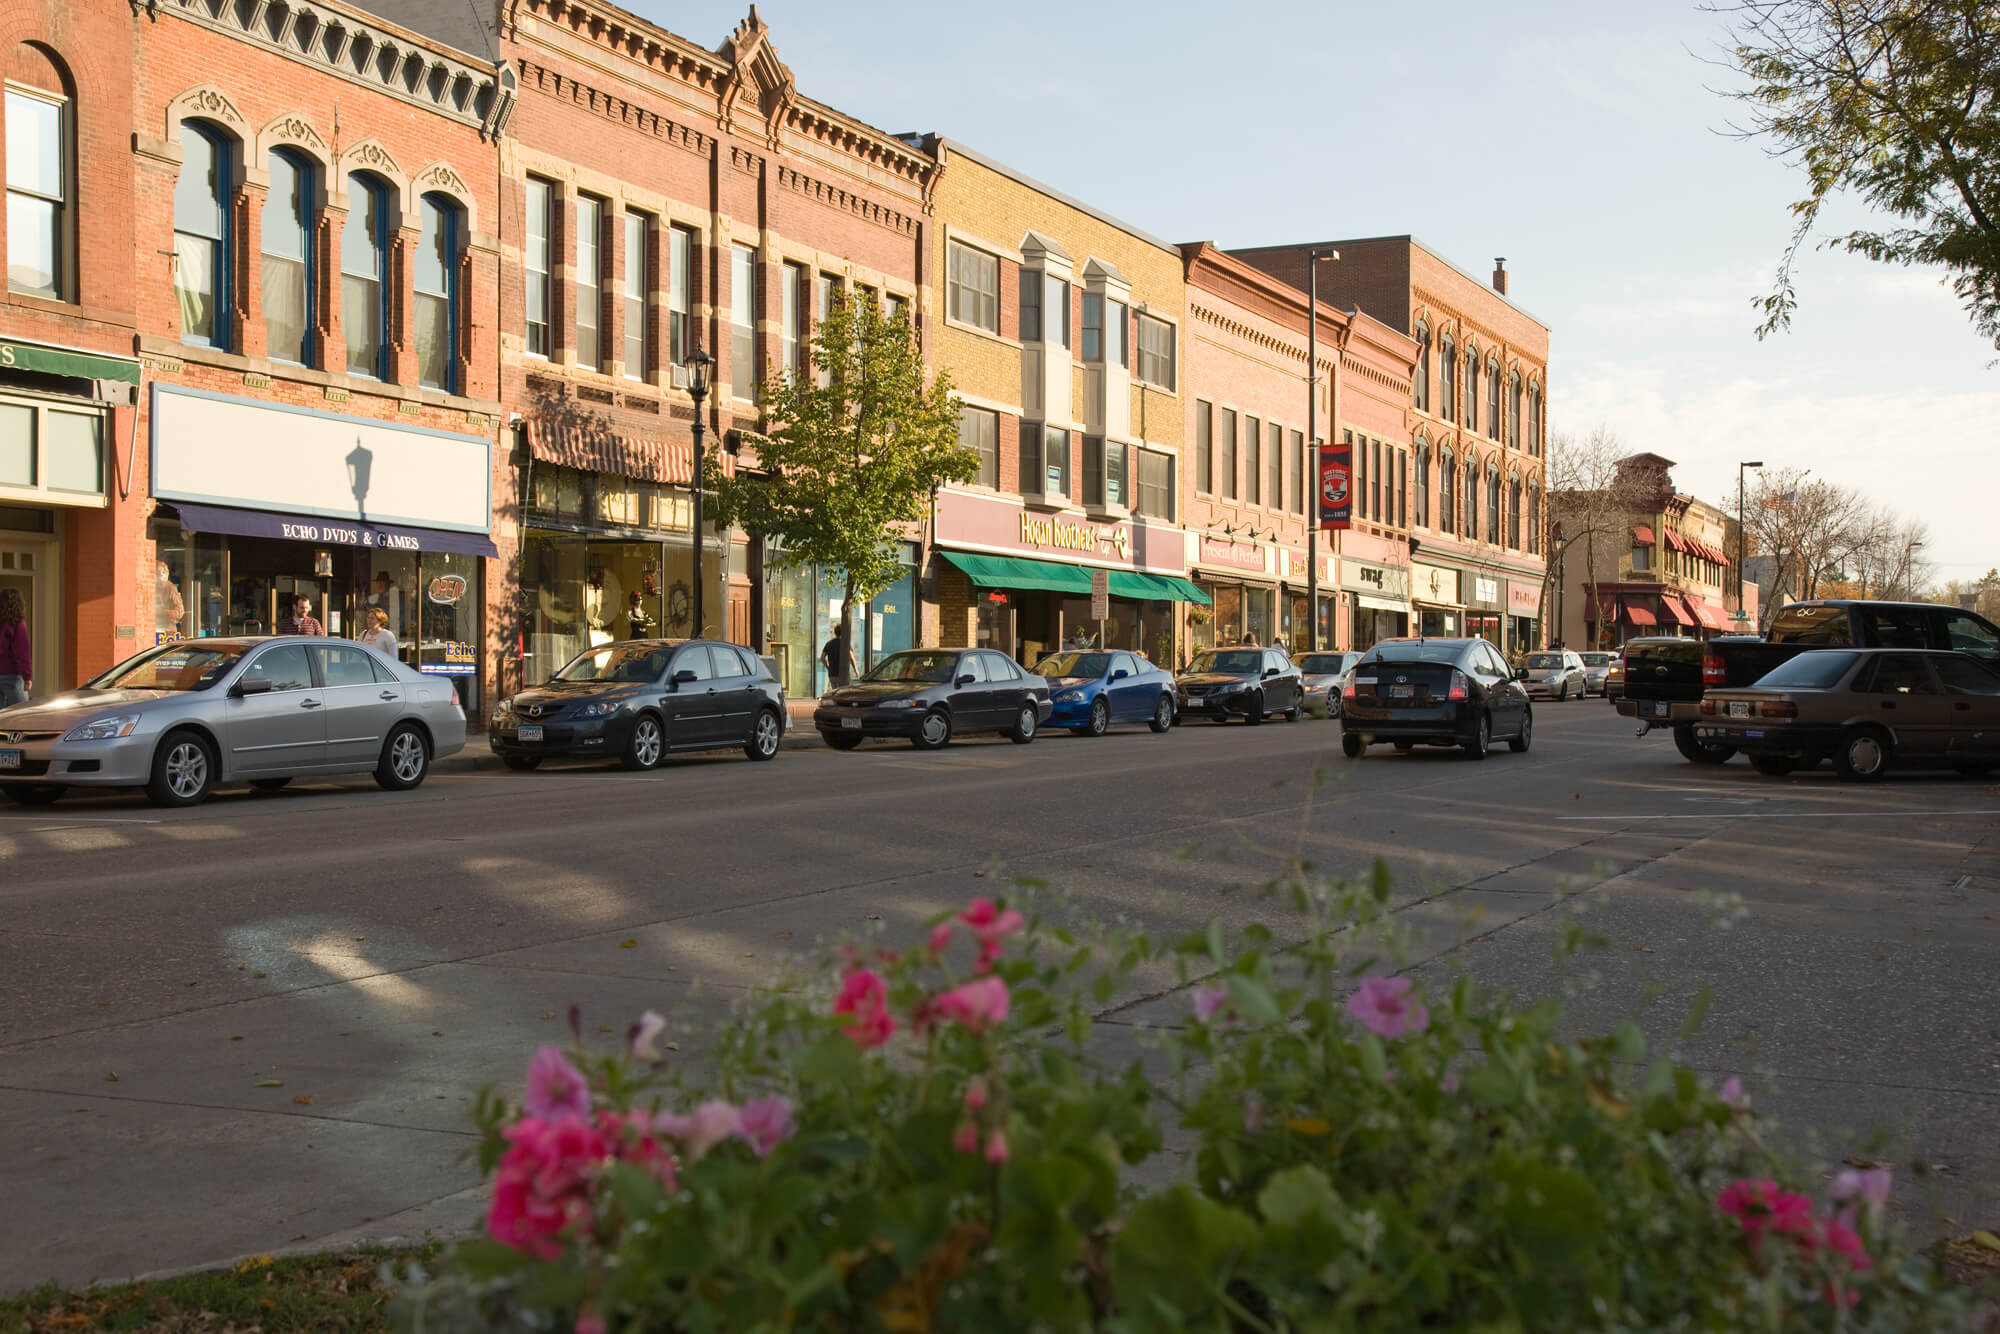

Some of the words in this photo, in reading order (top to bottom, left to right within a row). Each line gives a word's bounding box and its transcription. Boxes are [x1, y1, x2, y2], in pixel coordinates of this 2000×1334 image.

[282, 523, 318, 540] ECHO
[323, 527, 357, 543] DVD'S
[363, 532, 372, 545] &
[377, 533, 419, 550] GAMES
[429, 577, 465, 600] OPEN
[1360, 567, 1383, 589] swag
[446, 641, 476, 657] Echo
